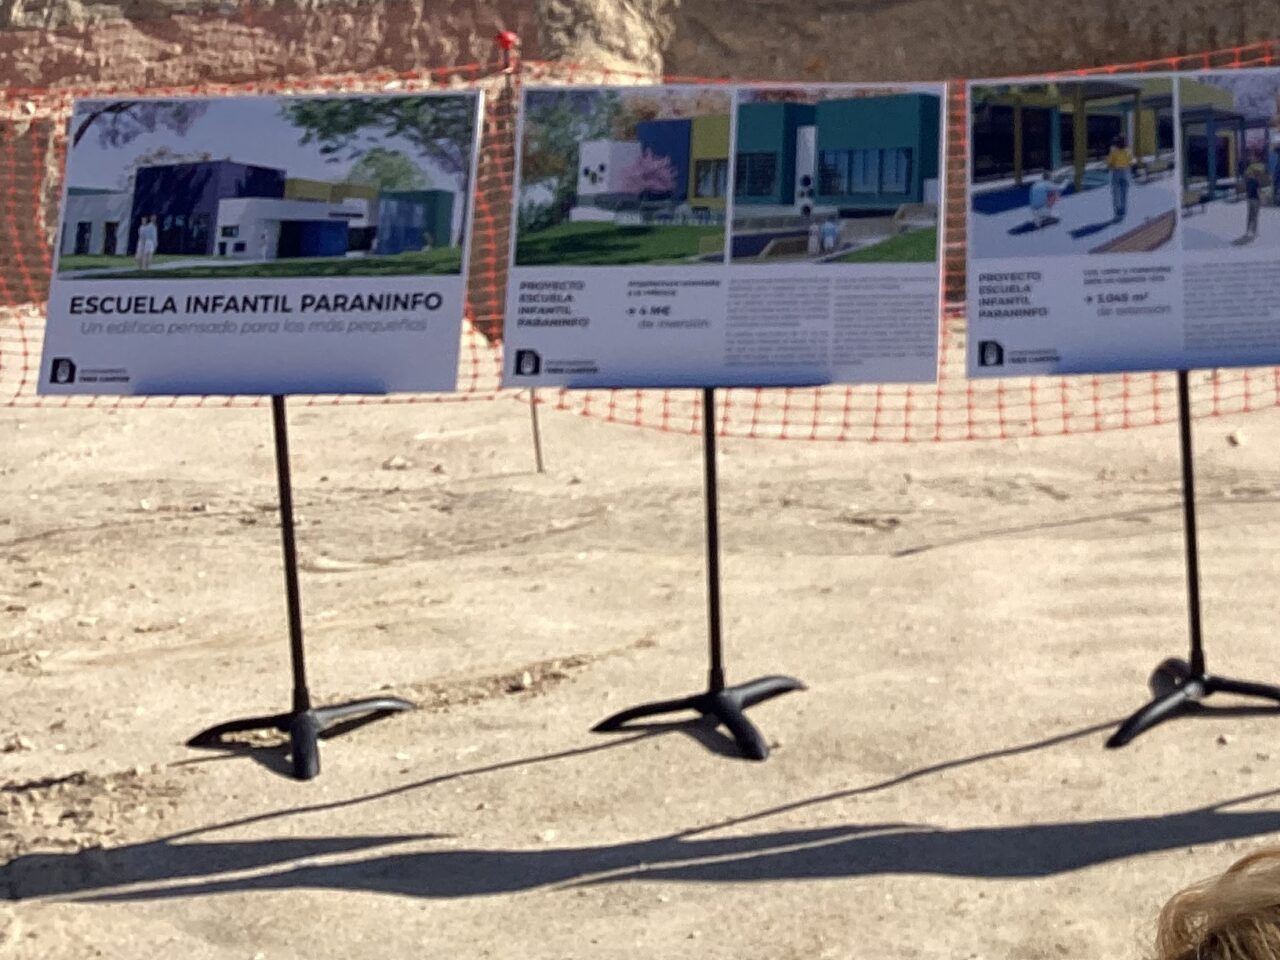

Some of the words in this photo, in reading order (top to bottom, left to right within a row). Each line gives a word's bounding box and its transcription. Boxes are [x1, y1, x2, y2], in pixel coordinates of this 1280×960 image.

[978, 271, 1042, 282] PROYECTO
[69, 295, 177, 315] ESCUELA
[185, 294, 292, 313] INFANTIL
[301, 292, 443, 312] PARANINFO
[978, 307, 1048, 319] PARANINFO
[81, 321, 103, 335] Un
[106, 320, 165, 335] edificio
[167, 320, 238, 337] pensado
[240, 320, 280, 336] para
